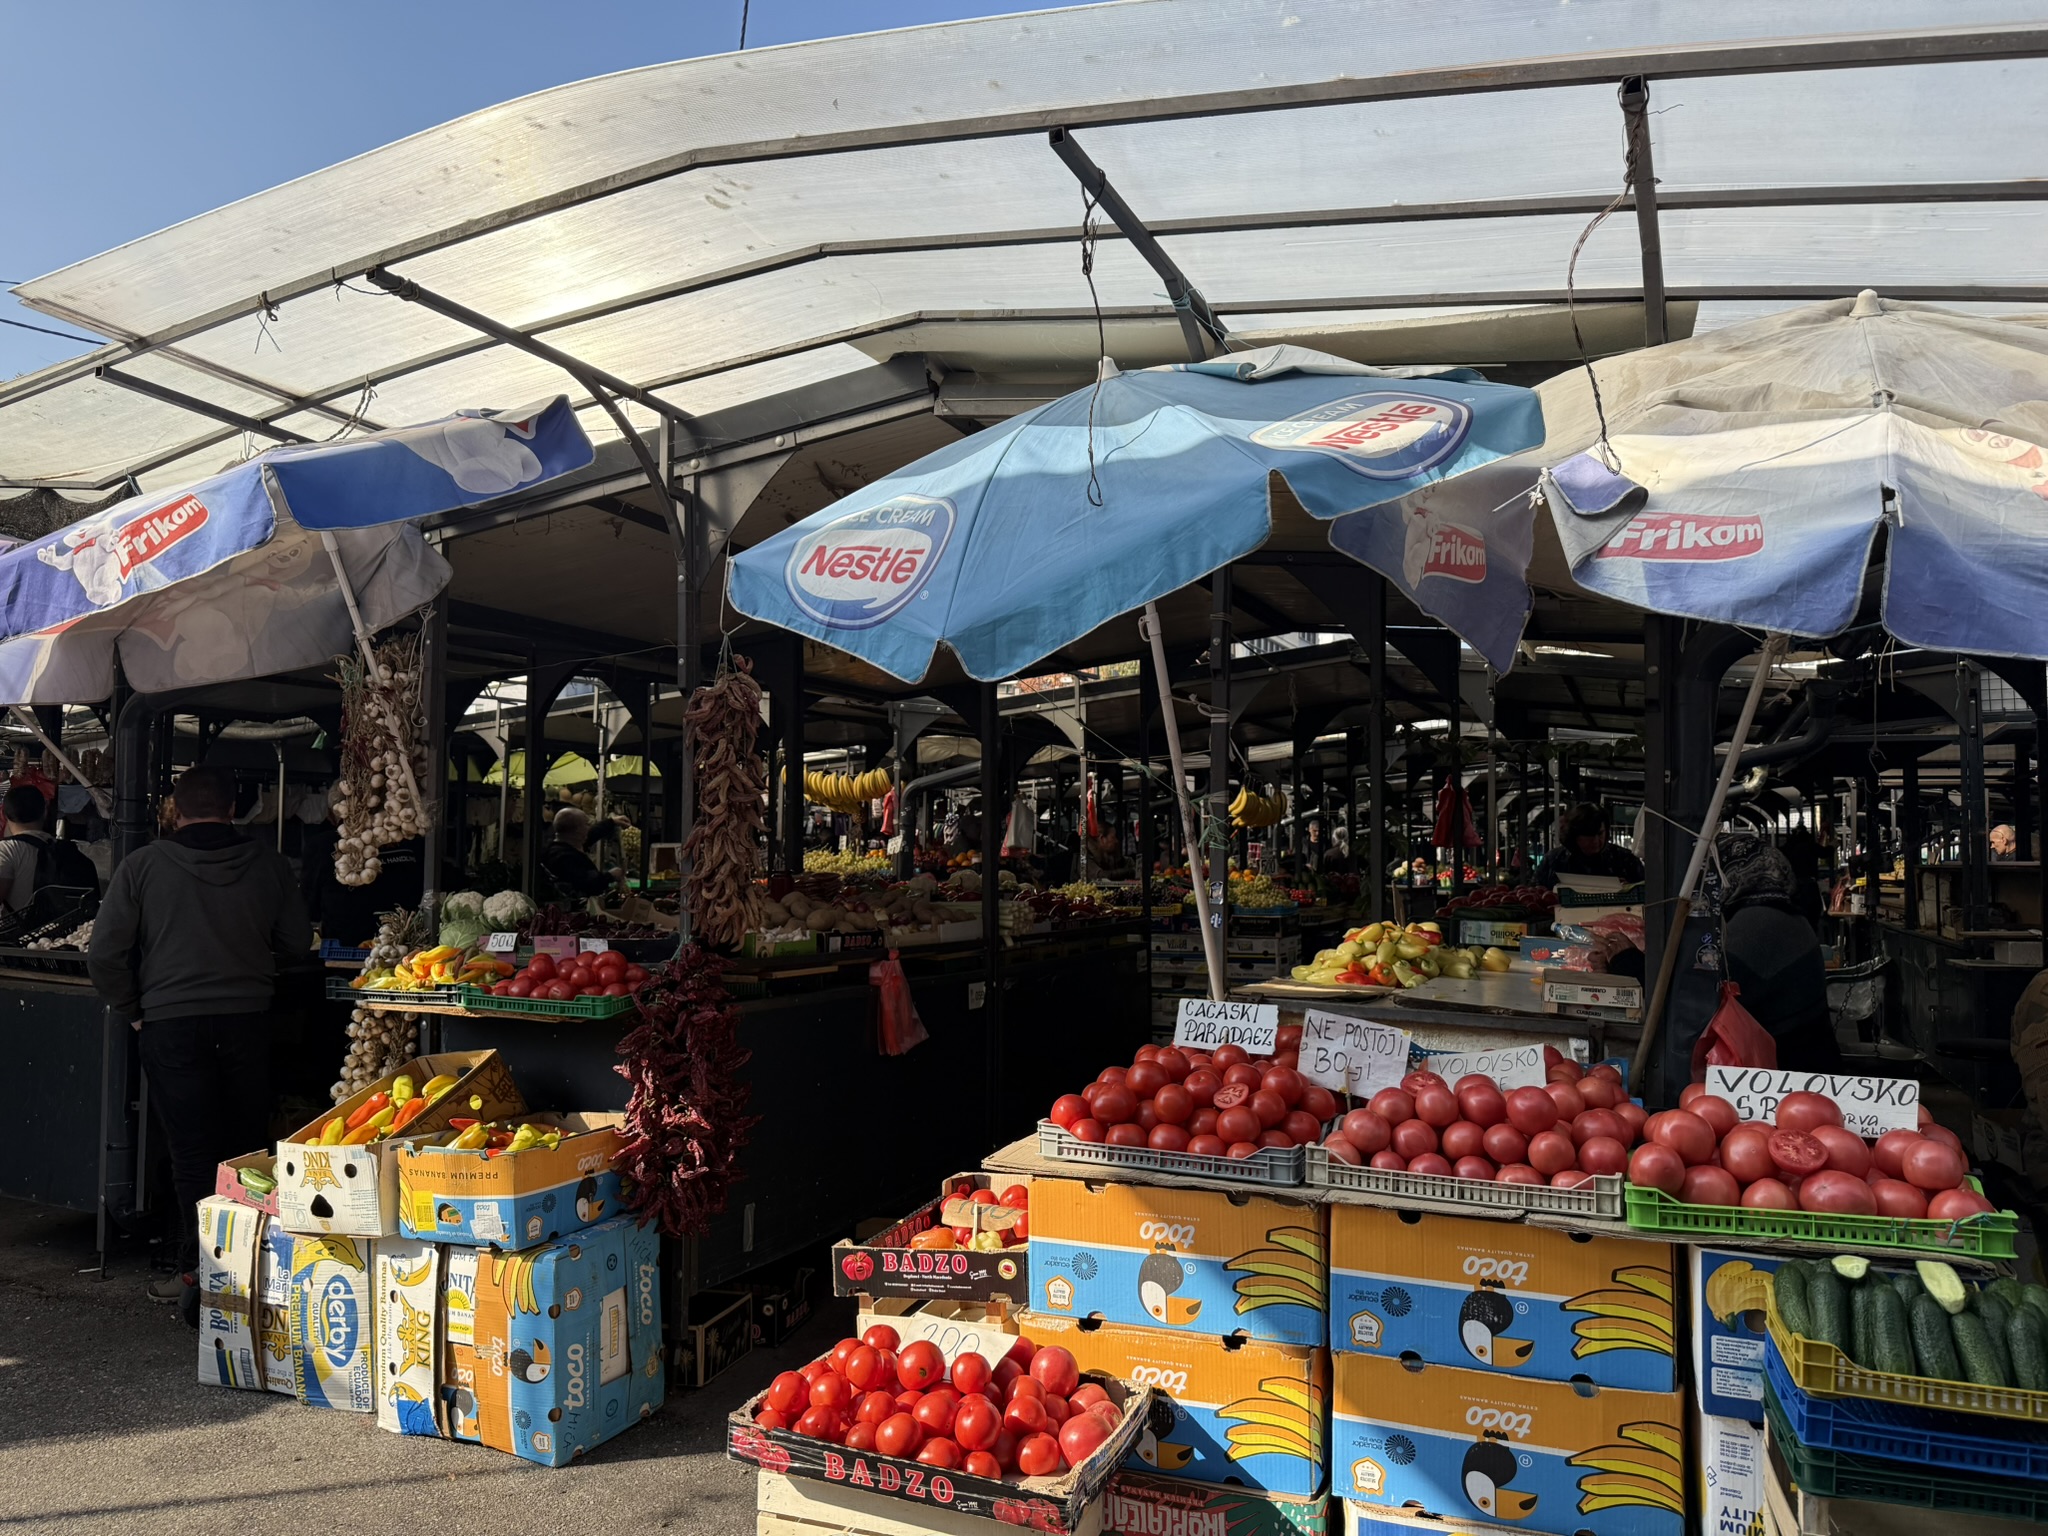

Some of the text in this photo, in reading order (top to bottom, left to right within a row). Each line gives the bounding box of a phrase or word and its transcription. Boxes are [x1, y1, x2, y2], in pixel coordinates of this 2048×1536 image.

[1297, 402, 1365, 430] CREAM
[1308, 403, 1437, 450] Nestlé
[876, 506, 937, 527] CREAM
[115, 498, 204, 568] Frikom
[1606, 519, 1764, 550] Frikom
[800, 545, 926, 584] Nestlé
[1427, 534, 1486, 567] Frikom
[1305, 1016, 1336, 1041] NE
[1437, 1048, 1539, 1075] VOLOVSKO
[303, 1150, 332, 1168] KING
[577, 1153, 604, 1171] toco
[409, 1168, 499, 1181] PREMIUM BANANAS
[885, 1218, 923, 1248] BADZO
[1139, 1220, 1195, 1249] toco
[1456, 1245, 1486, 1253] BANANAS
[1487, 1248, 1513, 1256] QUALITY
[278, 1266, 290, 1280] La
[882, 1252, 968, 1275] BADZO
[1044, 1260, 1071, 1269] ecuador
[1462, 1255, 1528, 1286] toco
[209, 1270, 231, 1333] BOTA
[639, 1262, 655, 1326] toco
[1348, 1293, 1379, 1304] ecuador
[262, 1307, 290, 1332] ING
[291, 1284, 302, 1346] PREMIUM
[323, 1280, 355, 1361] derby
[380, 1309, 388, 1346] Quality
[416, 1309, 431, 1370] KING
[491, 1335, 506, 1377] toco
[353, 1365, 362, 1410] ECUADOR
[451, 1368, 473, 1382] oco
[563, 1343, 585, 1411] toco
[1131, 1365, 1188, 1395] toco
[363, 1396, 370, 1410] OF
[1459, 1395, 1539, 1411] EXTRA QUALITY BANANAS
[1465, 1405, 1532, 1439] toco
[1352, 1440, 1383, 1450] ecuador
[823, 1451, 955, 1503] BADZO
[1120, 1485, 1205, 1508] PREMIUM BANANAS
[1720, 1505, 1764, 1525] LITY
[1720, 1519, 1766, 1536] MIUM
